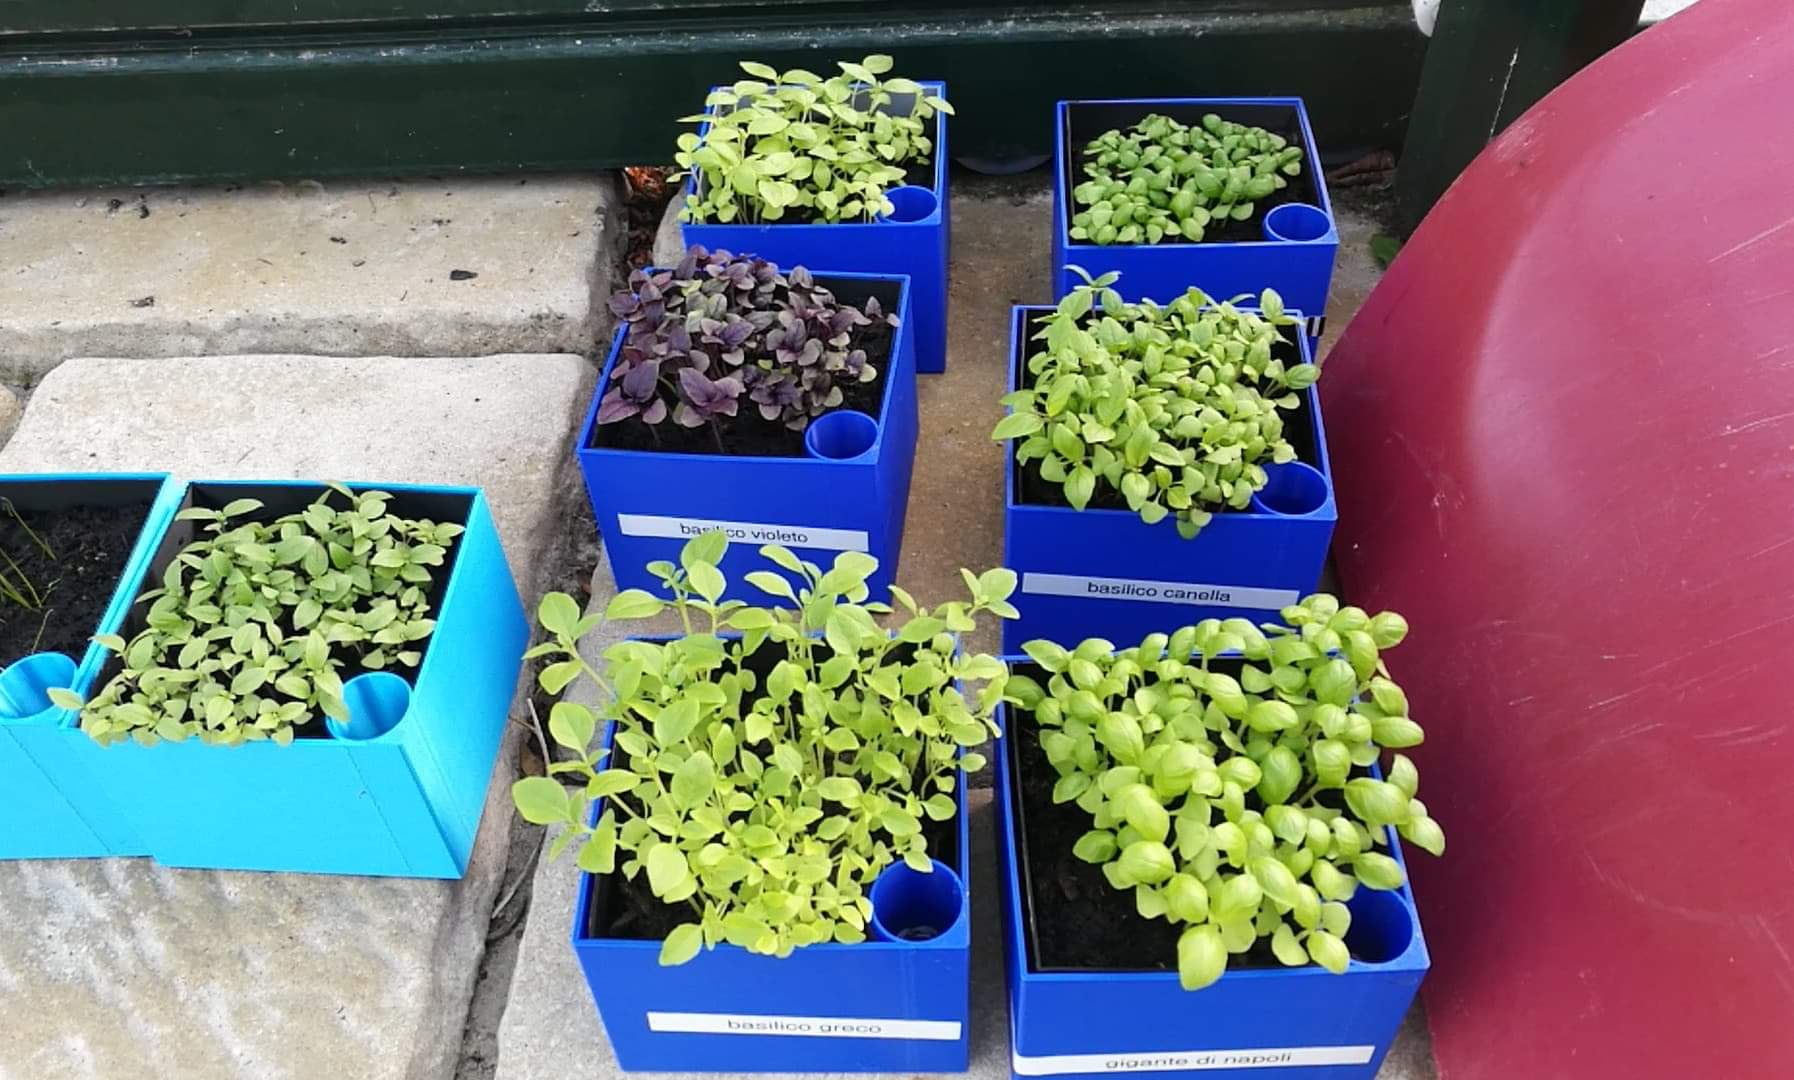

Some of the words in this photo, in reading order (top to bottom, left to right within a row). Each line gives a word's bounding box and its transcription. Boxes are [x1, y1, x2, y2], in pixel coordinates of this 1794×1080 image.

[679, 522, 746, 538] basco
[751, 527, 809, 543] violeto
[1087, 582, 1157, 597] basilico
[1163, 587, 1231, 601] canella
[727, 1019, 812, 1032] basilico
[819, 1024, 882, 1033] greco
[1105, 1058, 1189, 1070] gigante
[1196, 1055, 1216, 1066] di
[1223, 1052, 1292, 1067] napoli
